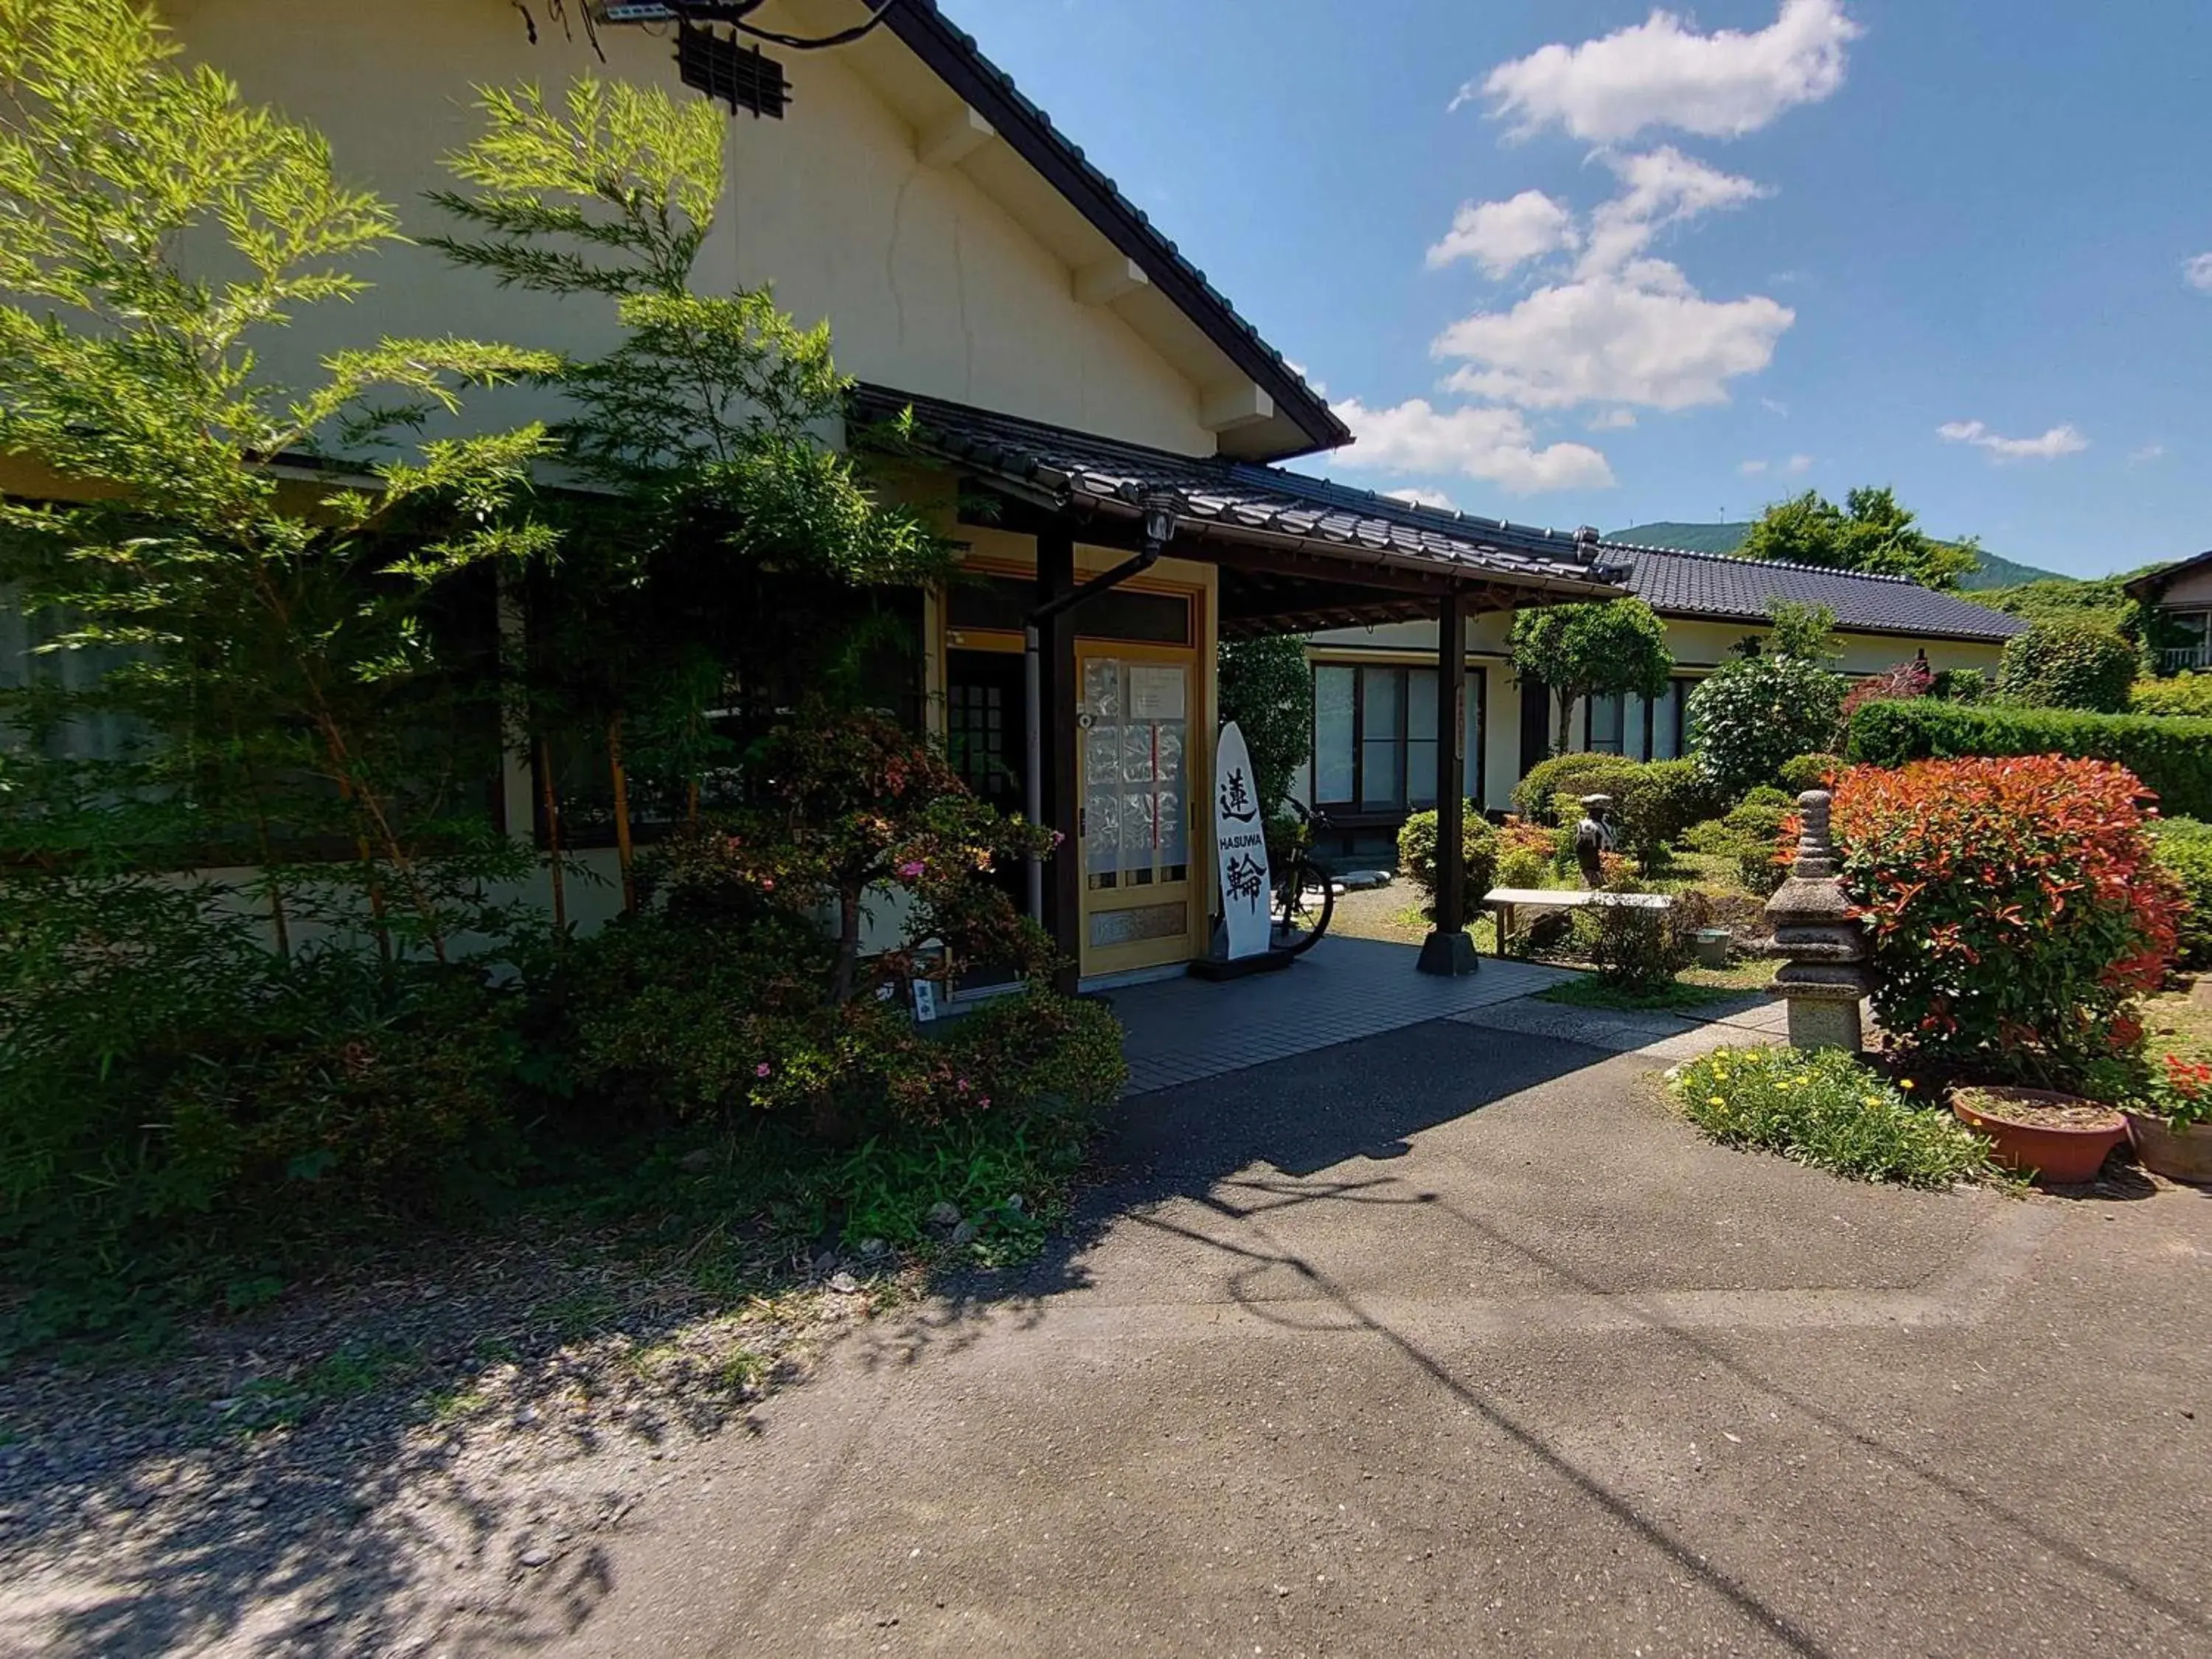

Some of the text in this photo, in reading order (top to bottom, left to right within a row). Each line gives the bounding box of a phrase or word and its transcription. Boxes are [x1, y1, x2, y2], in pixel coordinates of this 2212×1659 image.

[1220, 768, 1256, 823] 蓮
[1220, 834, 1262, 849] HASUWA
[1226, 853, 1267, 915] 輪
